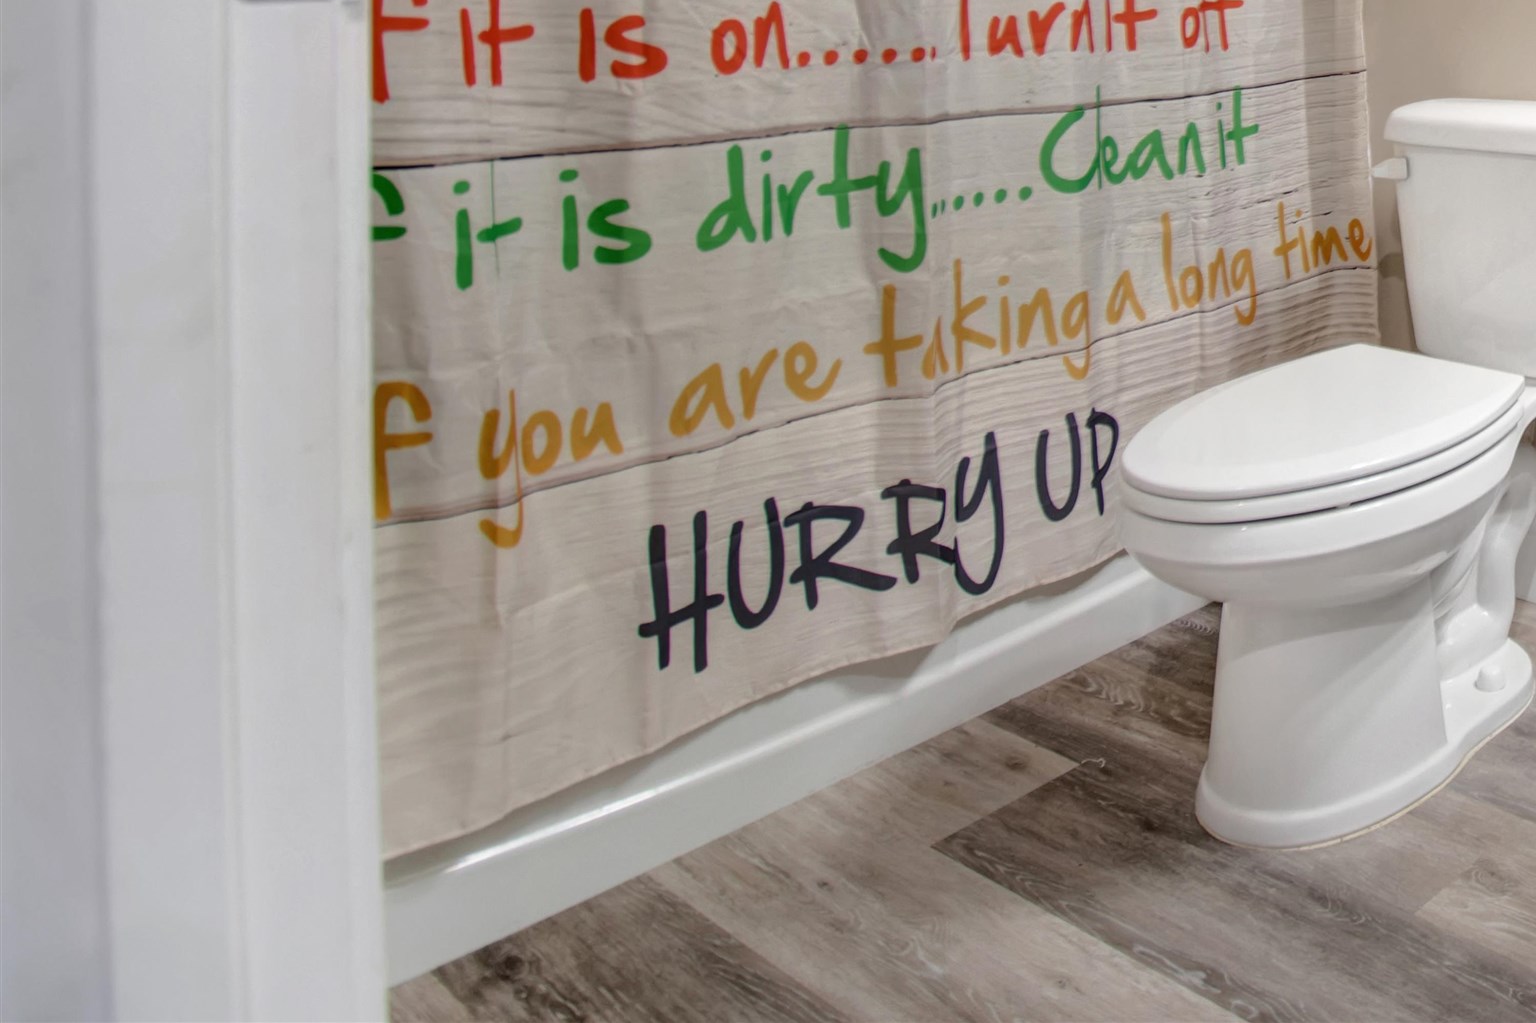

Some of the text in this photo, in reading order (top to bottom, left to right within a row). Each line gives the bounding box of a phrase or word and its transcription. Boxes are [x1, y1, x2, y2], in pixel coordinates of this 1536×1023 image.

[558, 168, 653, 273] is
[477, 388, 624, 550] you
[668, 340, 843, 439] are
[863, 257, 1091, 389] taking
[1105, 269, 1147, 326] a
[1160, 211, 1257, 328] long
[1273, 200, 1373, 281] time
[637, 406, 1121, 676] HURRY UP
